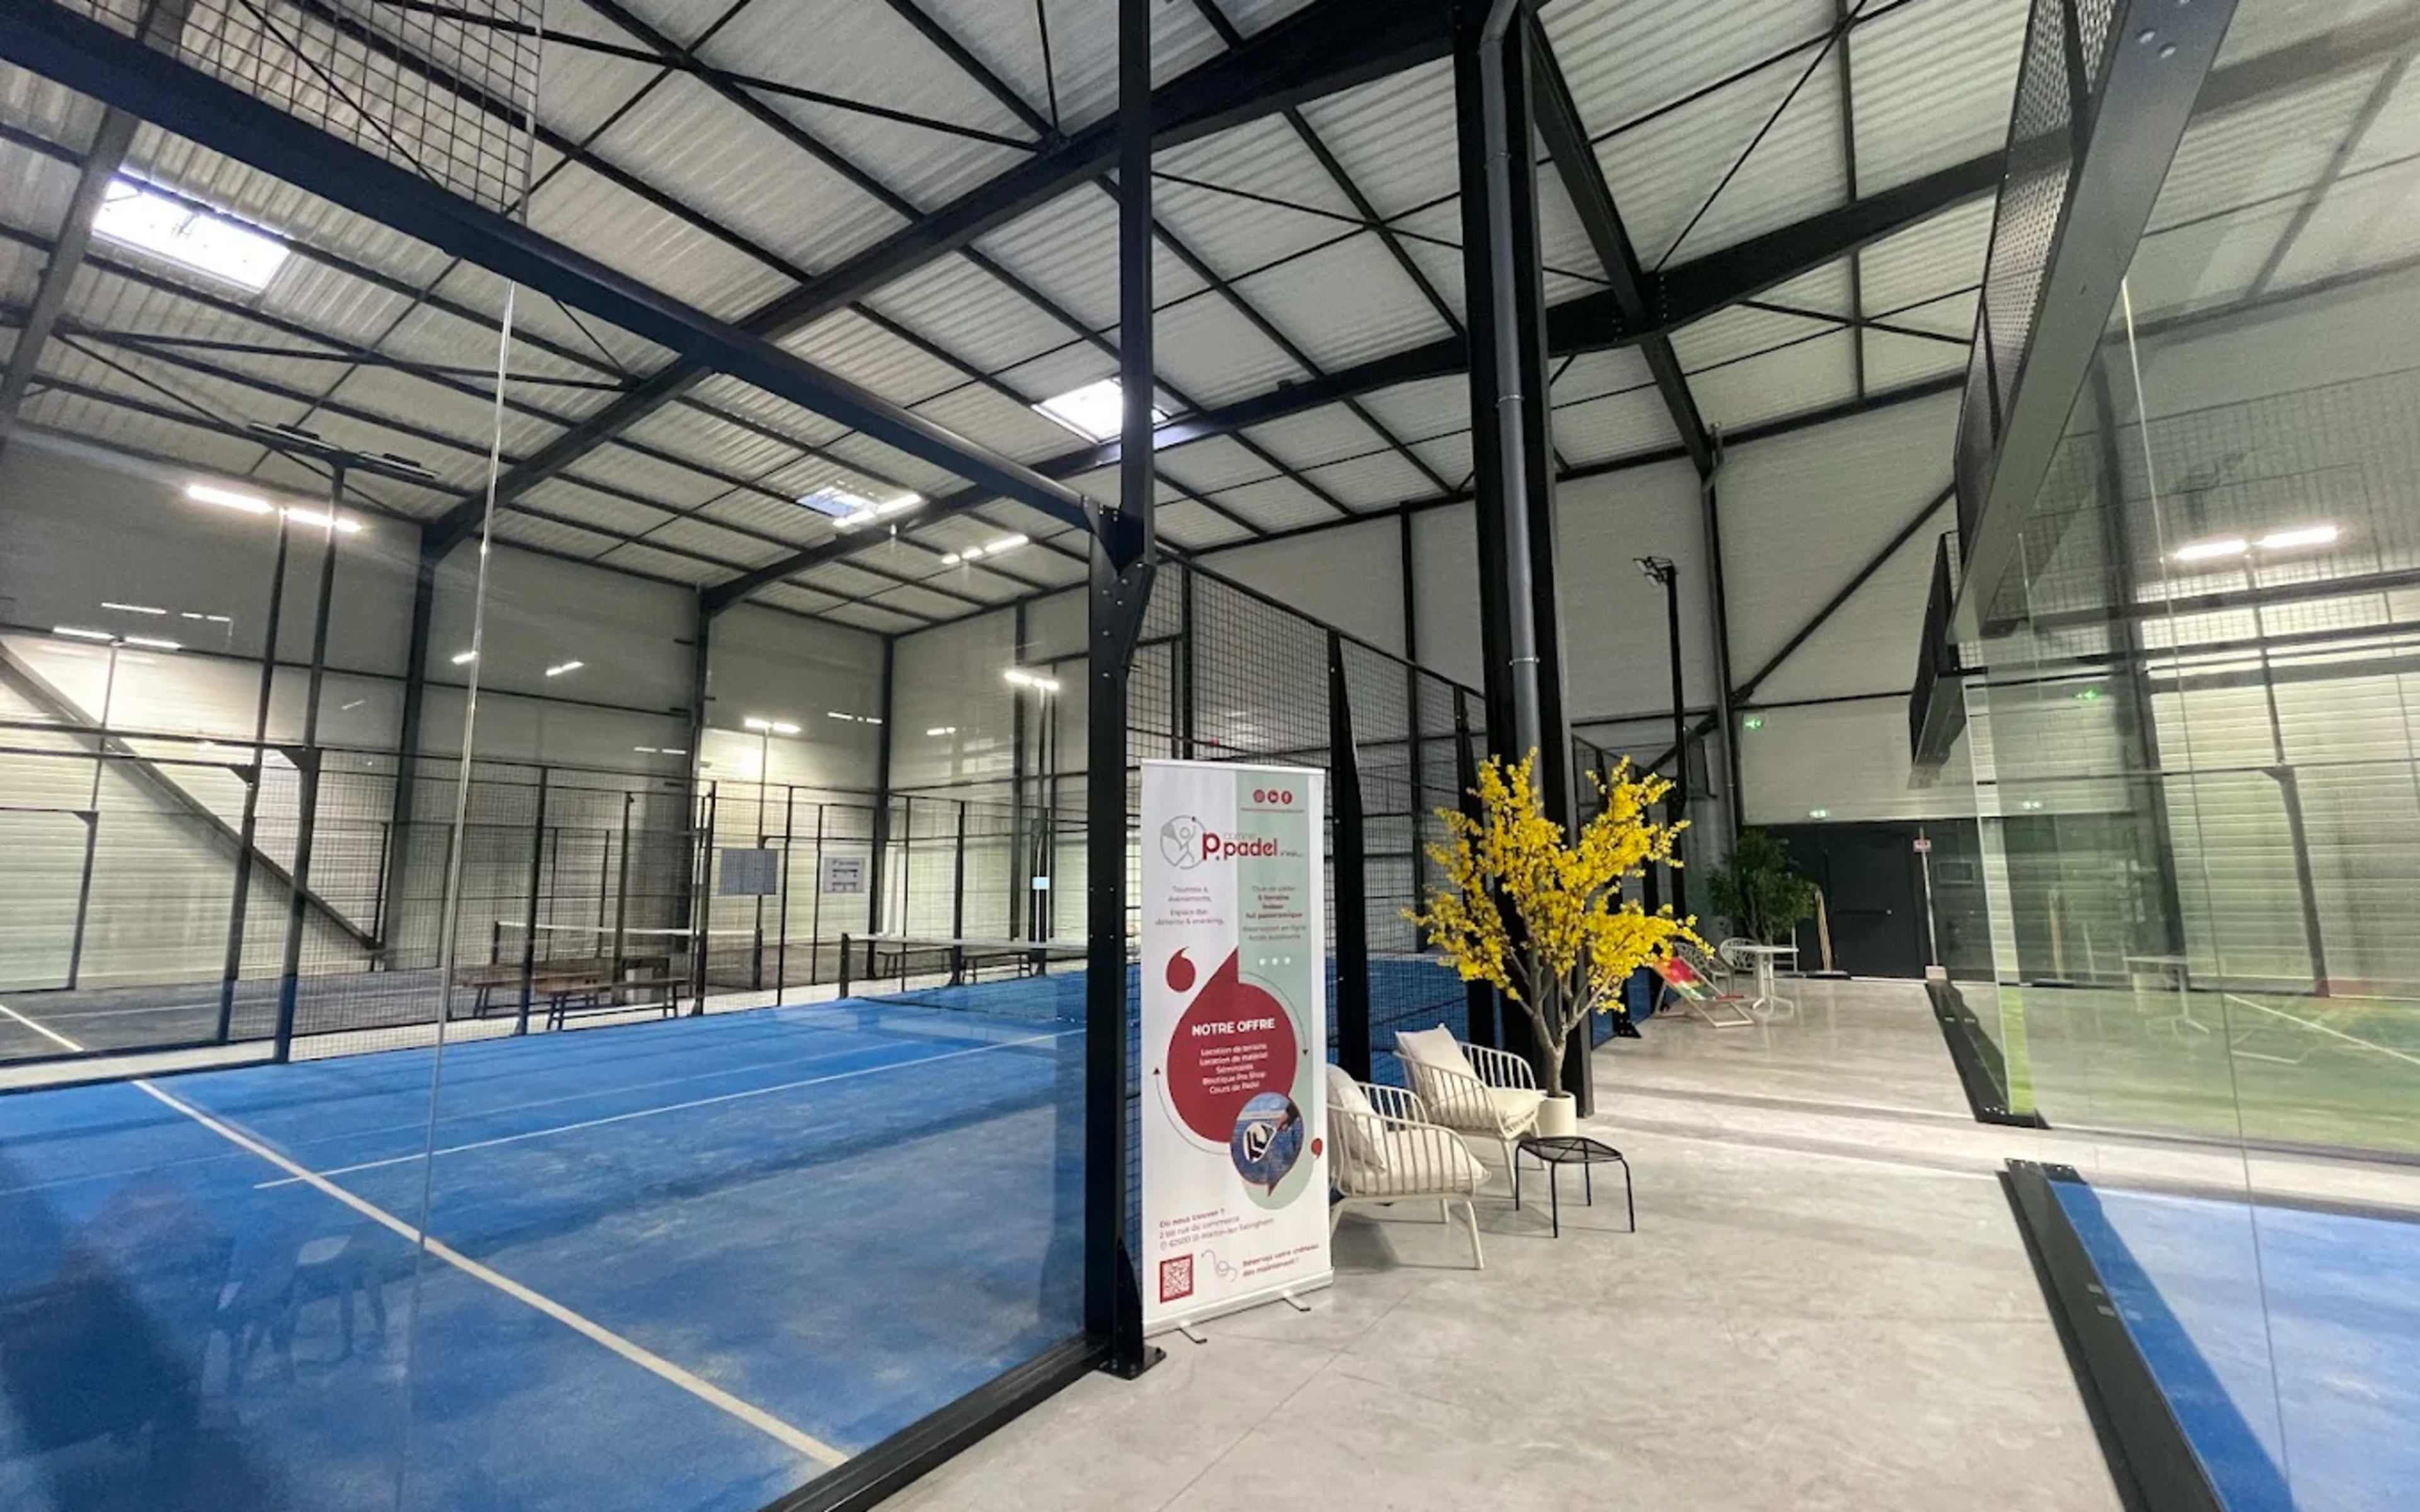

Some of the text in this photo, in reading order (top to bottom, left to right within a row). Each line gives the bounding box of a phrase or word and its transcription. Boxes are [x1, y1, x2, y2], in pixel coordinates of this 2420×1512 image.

[1192, 1018, 1275, 1036] NOTRE OFFRE
[1201, 1047, 1231, 1056] Location
[1242, 1043, 1267, 1051] terrains
[1199, 1057, 1230, 1066] Location
[1202, 1076, 1235, 1085] Boutique
[1248, 1071, 1266, 1079] Shop
[1209, 1085, 1230, 1094] Cours
[1242, 1080, 1260, 1089] Padel
[1172, 1217, 1190, 1226] nous
[1192, 1210, 1218, 1221] trouver
[1178, 1226, 1189, 1235] rue
[1191, 1223, 1200, 1232] du
